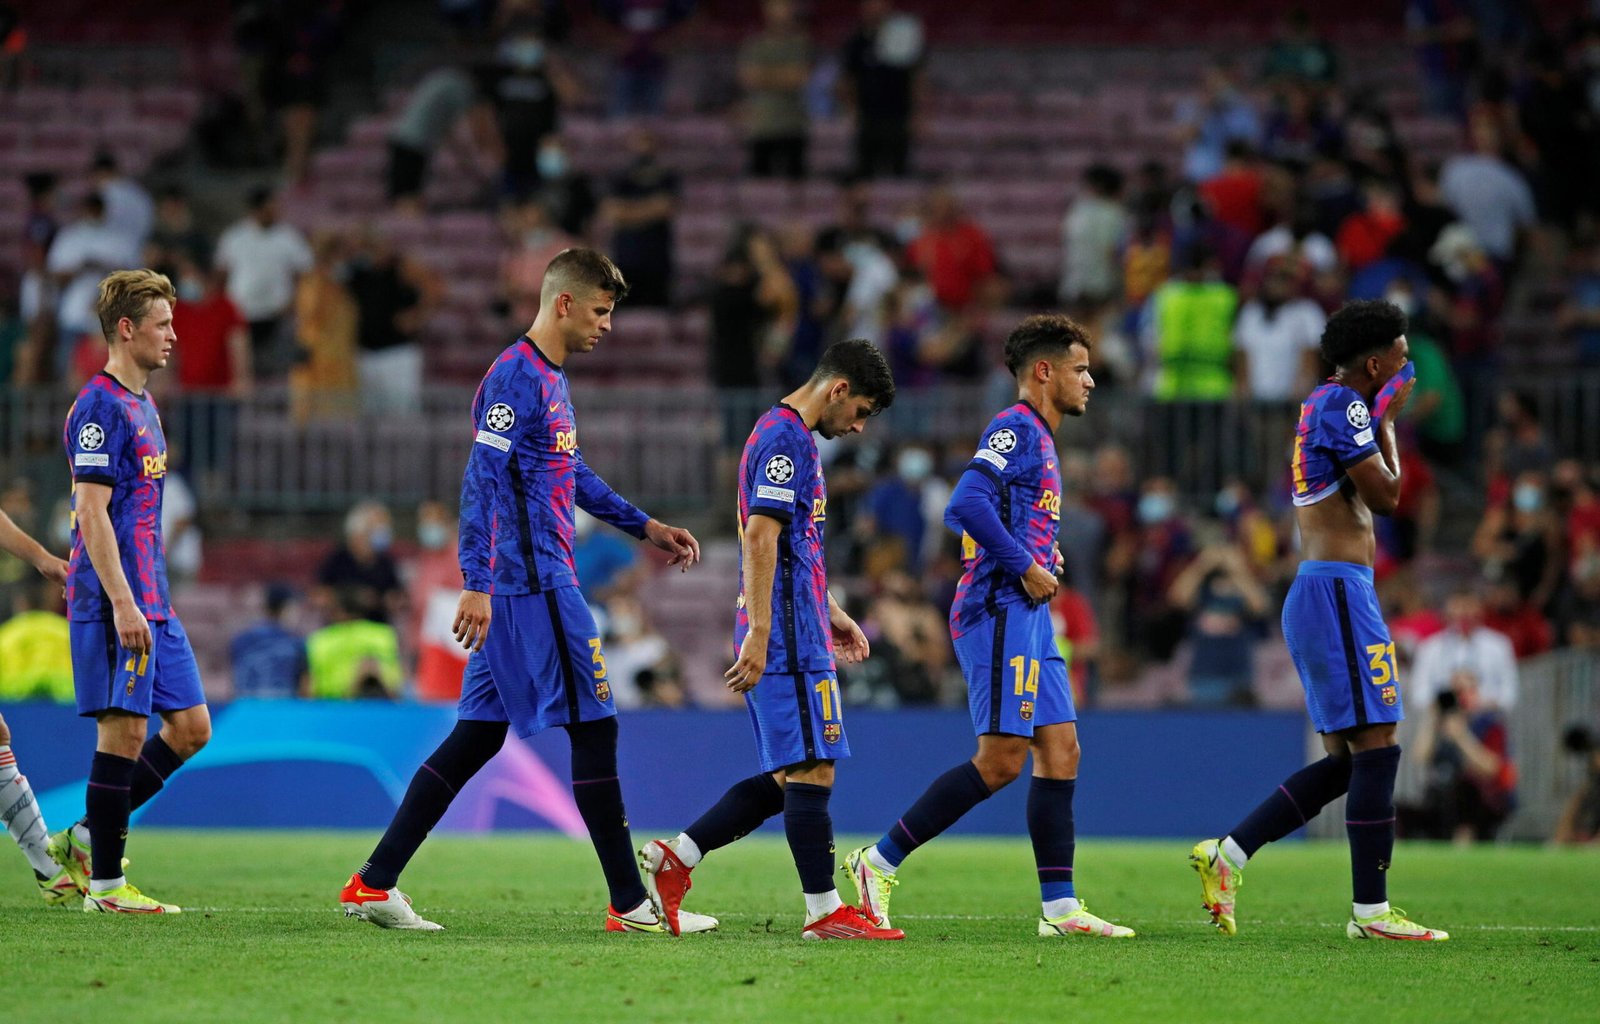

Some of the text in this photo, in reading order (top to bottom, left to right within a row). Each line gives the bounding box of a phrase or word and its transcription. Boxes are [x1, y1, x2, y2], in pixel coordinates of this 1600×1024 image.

[588, 637, 607, 679] 3
[1010, 655, 1040, 699] 14
[1366, 641, 1399, 685] 31
[815, 679, 842, 720] 11
